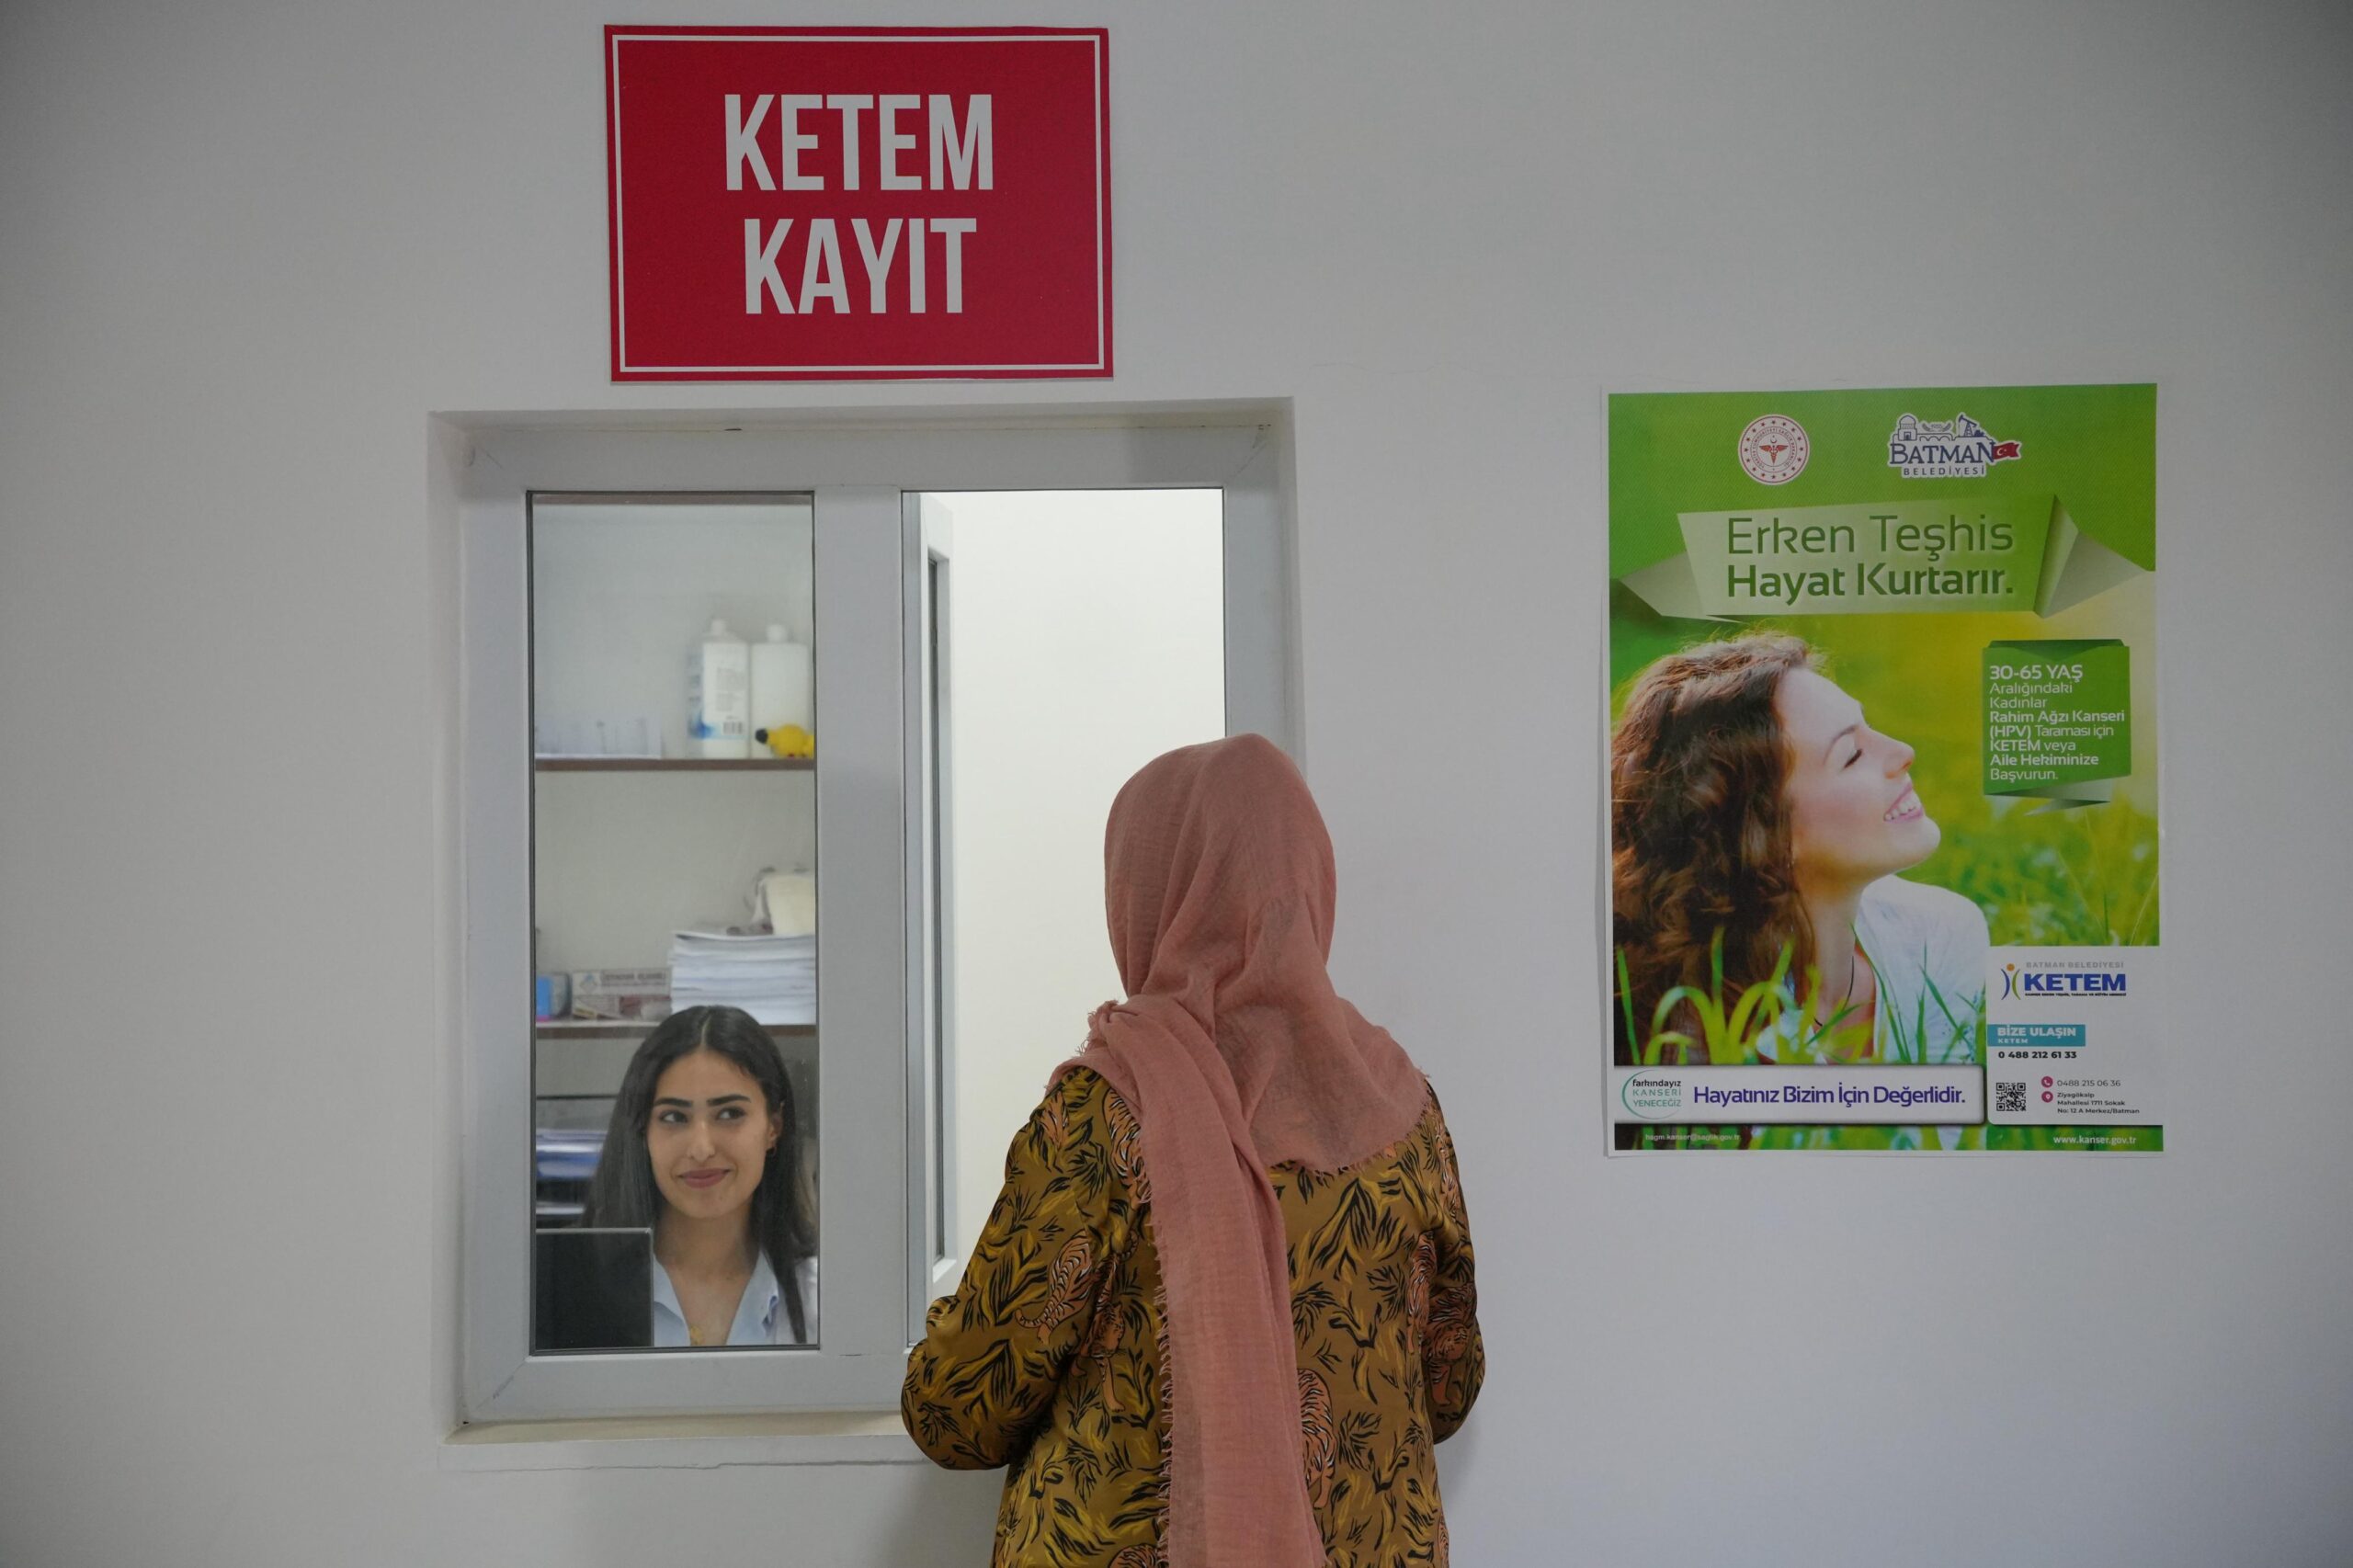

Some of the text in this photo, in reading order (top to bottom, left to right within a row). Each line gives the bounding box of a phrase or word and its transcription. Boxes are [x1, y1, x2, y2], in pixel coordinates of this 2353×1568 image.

[724, 94, 994, 191] KETEM
[744, 218, 977, 314] KAYIT
[1890, 441, 1996, 464] BATMAN
[1903, 465, 1984, 476] BELEDİYESİ
[1727, 514, 2014, 562] Erken Teşhis
[1727, 562, 2014, 606] Hayat Kurtarır.
[1989, 664, 2084, 683] 30-65 YAŞ
[1989, 681, 2074, 697] Aralığındaki
[1989, 697, 2048, 709] Kadınlar
[1989, 710, 2125, 725] Rahim Ağzı Kanseri
[1989, 724, 2114, 740] (HPV) Taraması için
[1990, 739, 2076, 754] KETEM veya
[1990, 753, 2099, 766] Aile Hekiminize
[1990, 768, 2059, 783] Başvurun.
[2067, 960, 2124, 969] BELEDİYESİ
[2024, 973, 2126, 991] KETEM
[1997, 1025, 2076, 1040] BİZE ULAŞIN
[1998, 1051, 2077, 1059] 0 488 212 61 33
[1632, 1078, 1682, 1088] farkındayız
[2056, 1079, 2121, 1087] 0488 215 06 36
[1632, 1087, 1682, 1096] KANSERİ
[1694, 1081, 1966, 1108] Hayatınız Bizim İçin Değerlidir.
[1632, 1099, 1682, 1108] YENECEĞİZ
[2052, 1135, 2137, 1146] www.kanser.gov.tr
